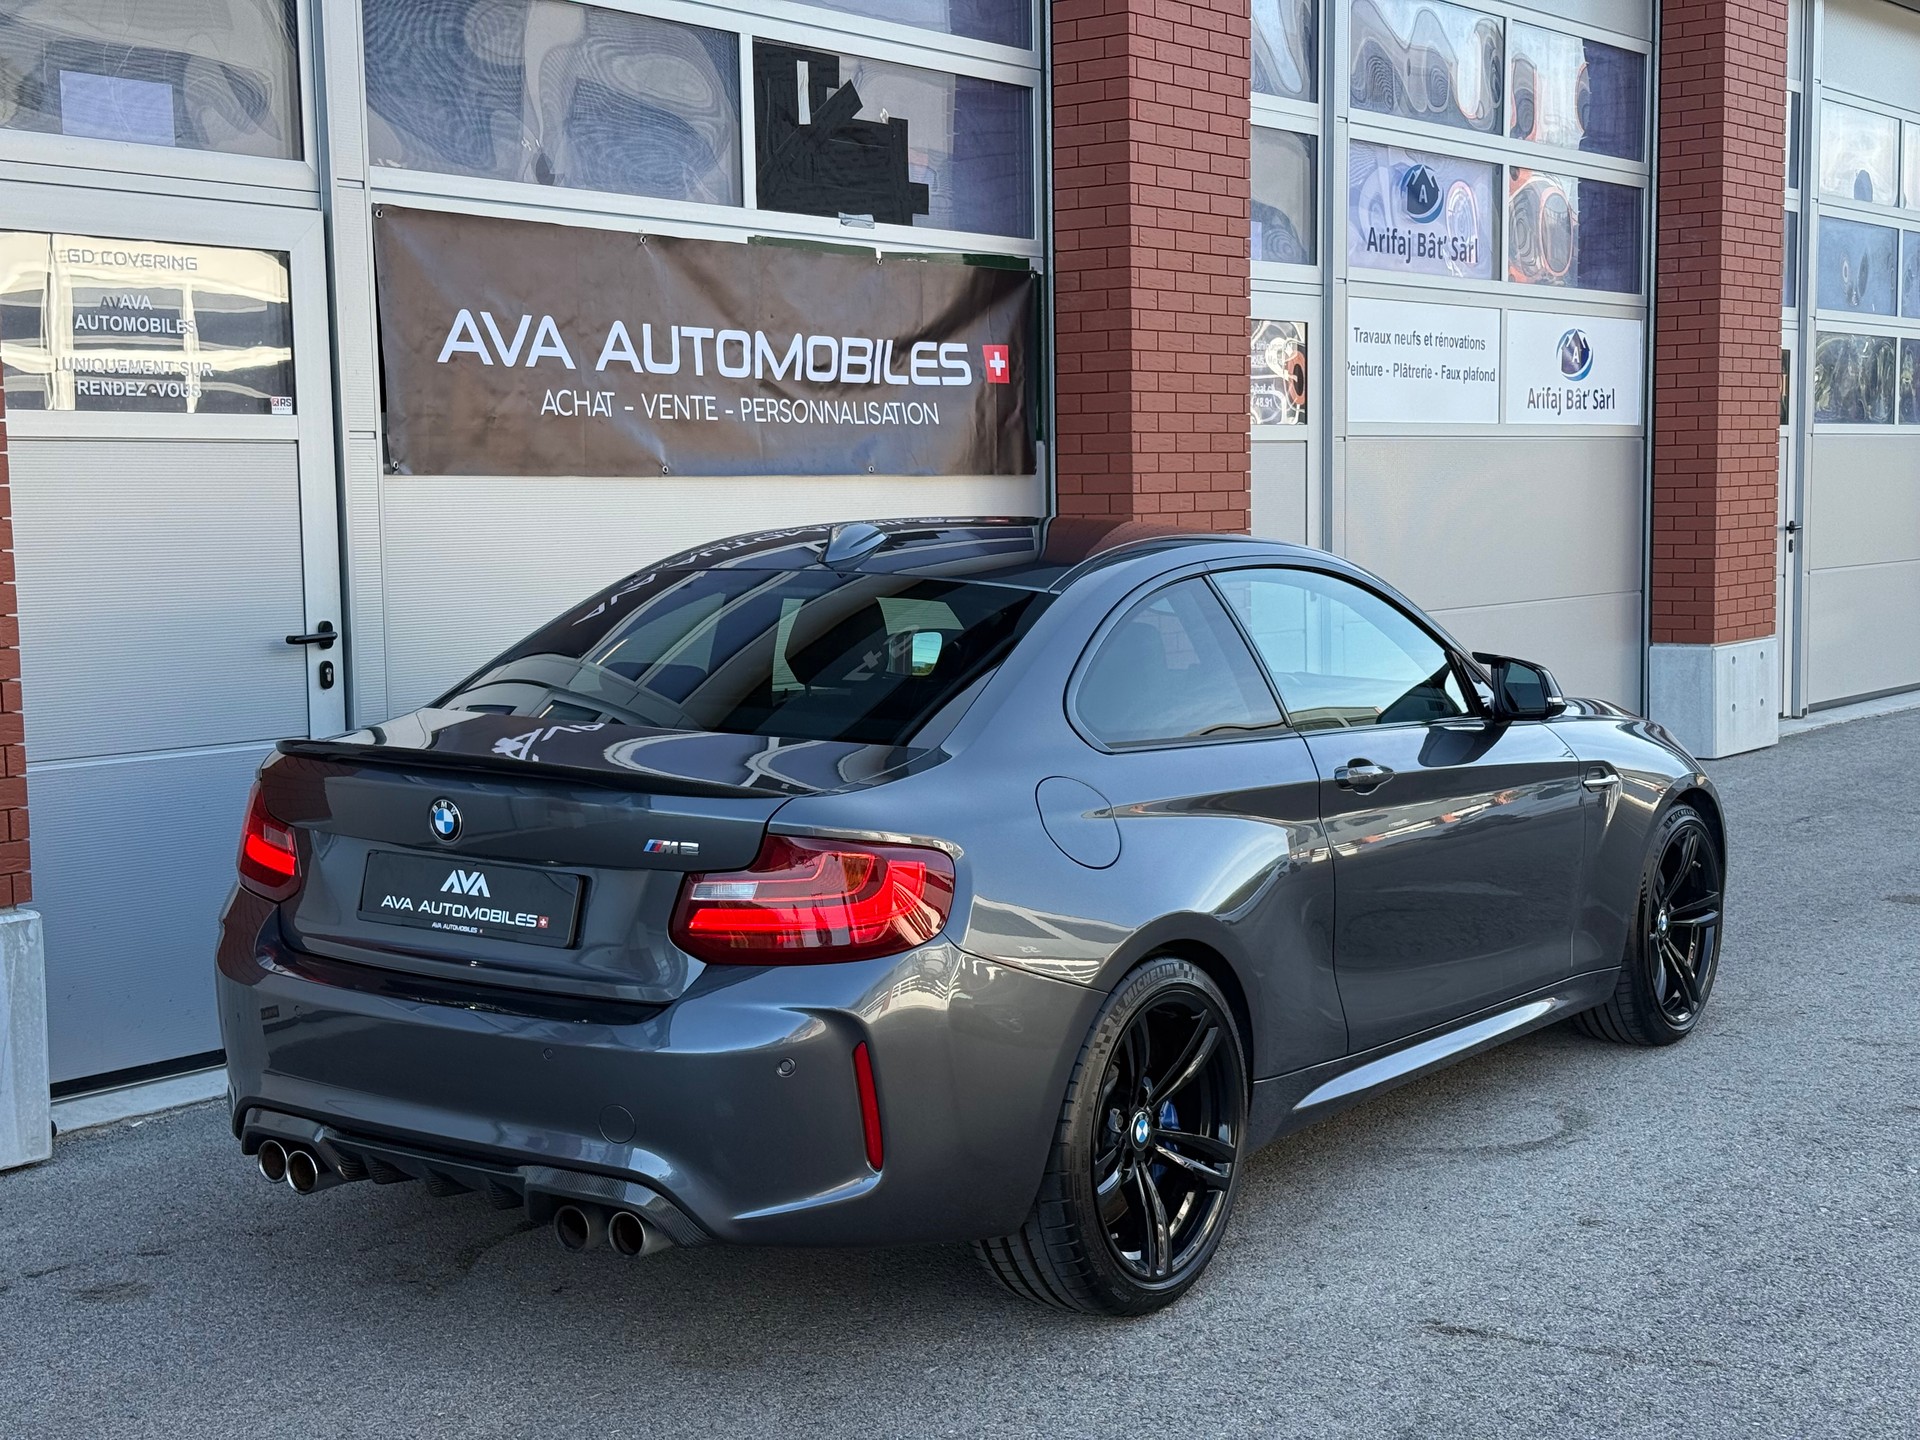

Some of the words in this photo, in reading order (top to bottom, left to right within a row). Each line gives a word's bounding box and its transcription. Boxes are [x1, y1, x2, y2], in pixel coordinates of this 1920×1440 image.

[1366, 226, 1411, 263] Arifaj
[1451, 236, 1478, 263] Sàrl
[101, 251, 198, 271] COVERING
[75, 314, 195, 334] AUTOMOBILES
[437, 307, 576, 370] AVA
[594, 318, 973, 387] AUTOMOBILES
[1353, 327, 1391, 344] Travaux
[1394, 330, 1421, 346] neufs
[1424, 333, 1433, 347] et
[1435, 331, 1486, 351] rénovations
[62, 357, 174, 376] UNIQUEMENT
[180, 361, 214, 377] SUR
[1393, 362, 1433, 379] Plâtrerie
[1441, 364, 1462, 380] Faux
[1463, 366, 1496, 384] plafond
[540, 388, 616, 418] ACHAT
[641, 395, 716, 422] VENTE
[740, 398, 939, 426] PERSONNALISATION
[1527, 387, 1562, 416] Arifaj
[1592, 388, 1615, 410] Sàrl
[658, 840, 700, 856] M2
[440, 868, 491, 898] AVA
[380, 894, 414, 912] AVA
[418, 900, 539, 928] AUTOMOBILES
[431, 921, 442, 929] AVA
[442, 923, 478, 934] AUTOMOBILES
[1124, 962, 1176, 1005] MICHELIN
